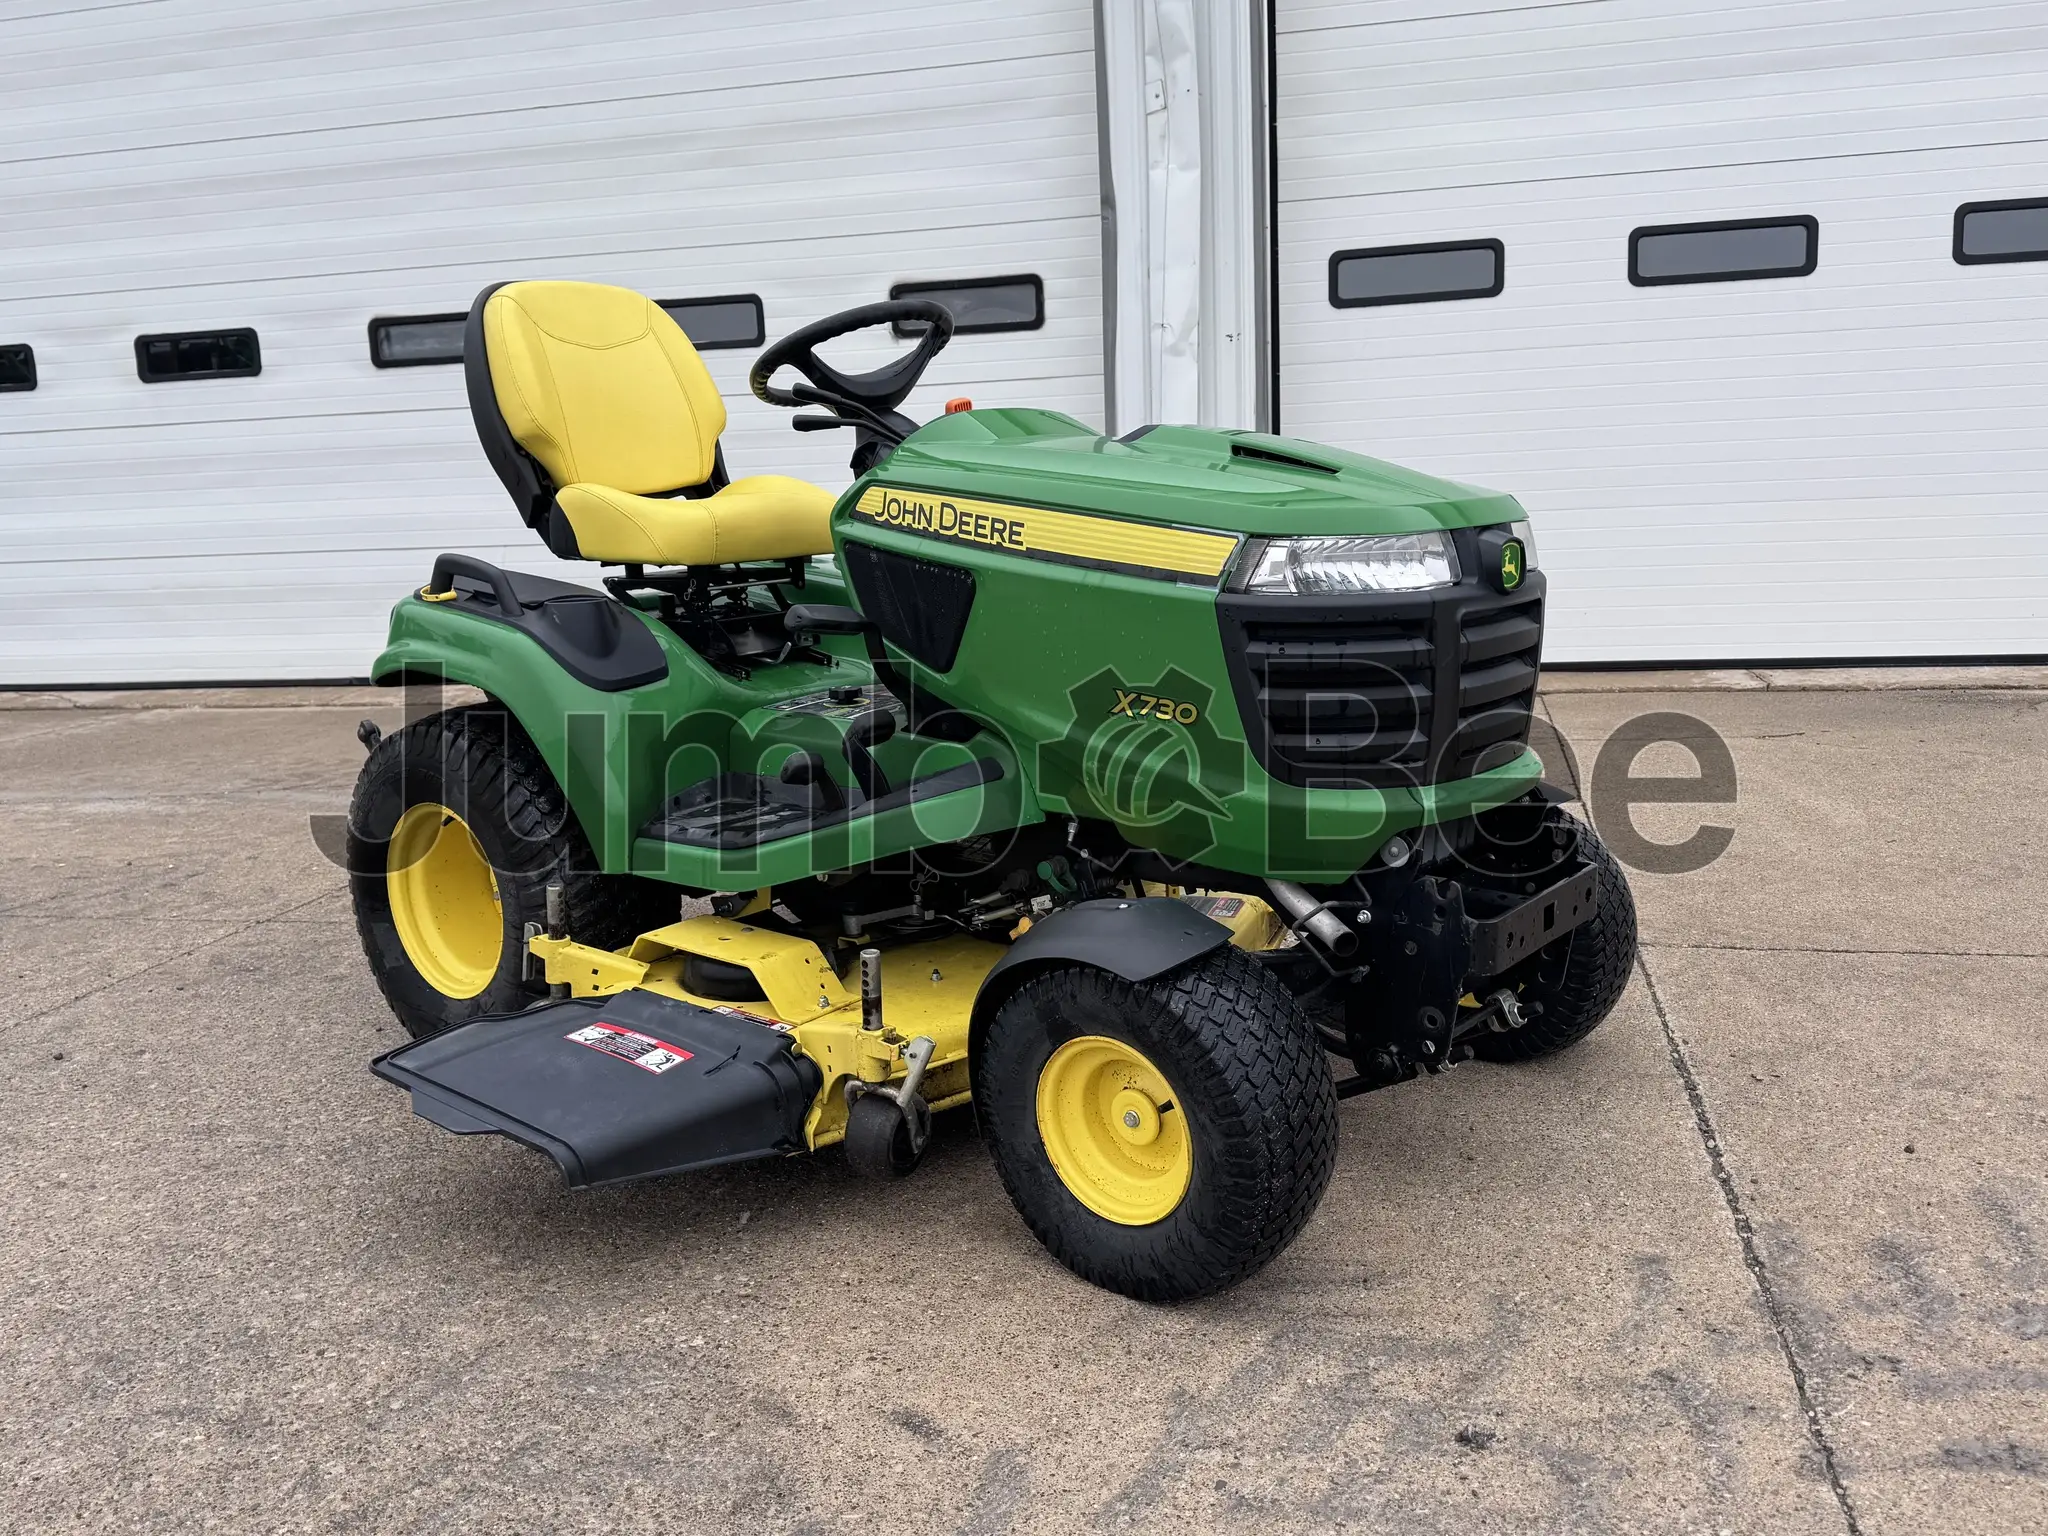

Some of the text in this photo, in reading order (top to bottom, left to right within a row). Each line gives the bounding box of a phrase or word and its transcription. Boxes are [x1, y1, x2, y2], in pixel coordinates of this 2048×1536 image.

[875, 491, 1025, 547] JOHN DEERE
[1108, 687, 1199, 725] X730
